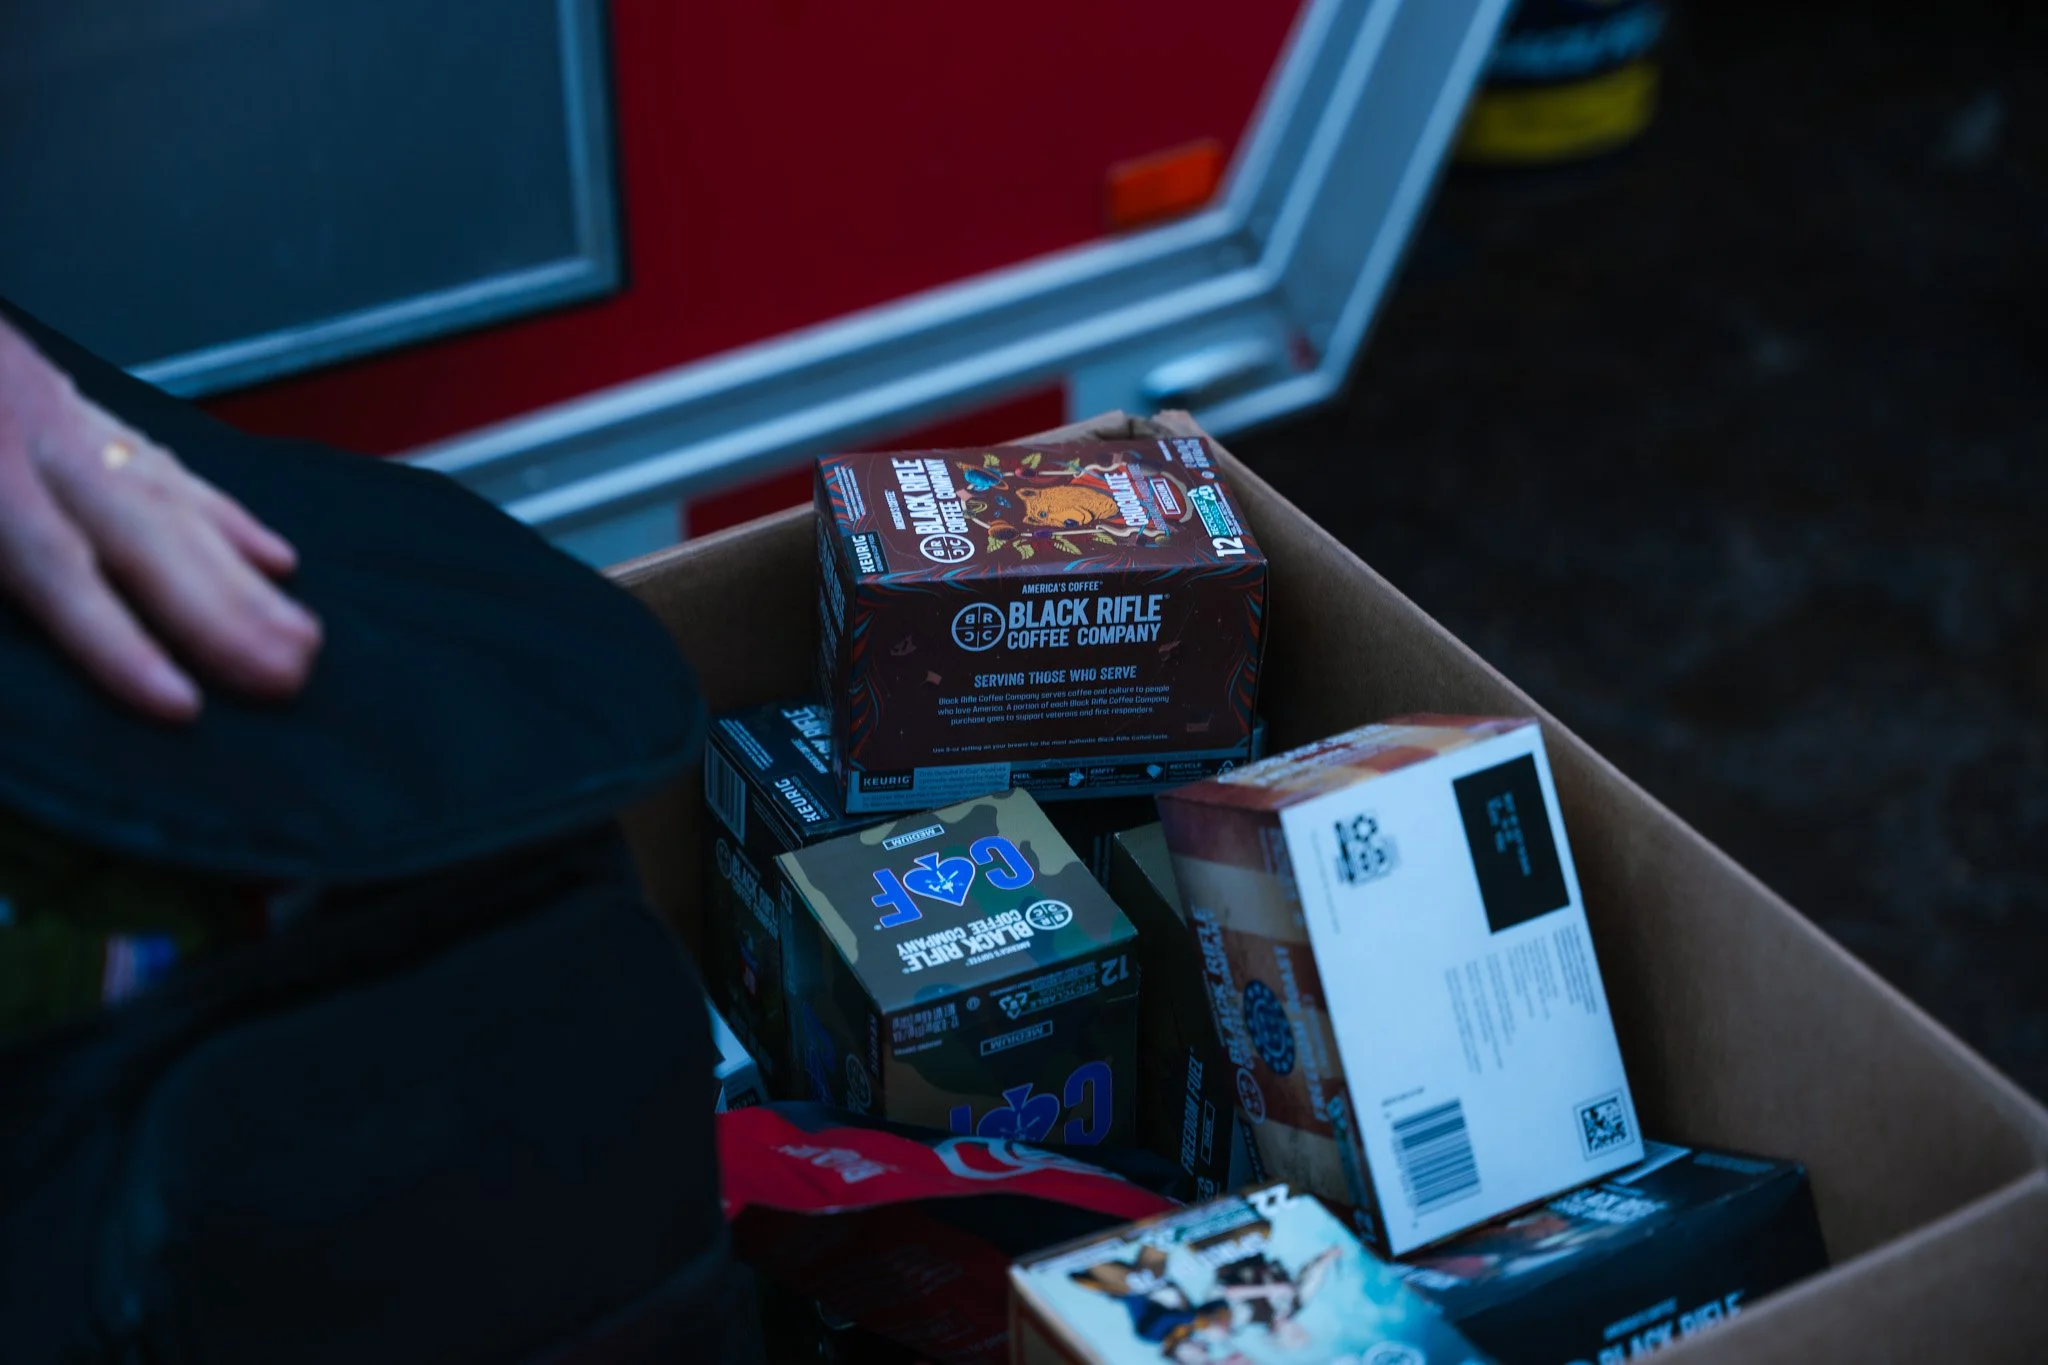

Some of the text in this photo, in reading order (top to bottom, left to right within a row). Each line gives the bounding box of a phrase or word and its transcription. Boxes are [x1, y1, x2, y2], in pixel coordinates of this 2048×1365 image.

[891, 457, 946, 534] BLACK RIFLE
[923, 458, 968, 533] COFFEE COMPANY
[1104, 472, 1149, 527] CHOCOLATE
[1155, 482, 1176, 511] MEDIUM
[852, 535, 876, 574] KEURIG
[1212, 537, 1246, 557] 12
[1022, 581, 1100, 595] AMERICA'S COFFEE
[1008, 594, 1164, 630] BLACK RIFLE
[1007, 622, 1162, 650] COFFEE COMPANY
[974, 664, 1138, 689] SERVING THOSE WHO SERVE
[937, 707, 954, 716] who
[955, 706, 971, 715] love
[1006, 703, 1012, 711] A
[1013, 701, 1040, 712] portion
[1041, 701, 1050, 710] of
[1050, 700, 1069, 709] each
[1069, 698, 1090, 708] Black
[1091, 697, 1108, 706] Rifle
[1109, 696, 1134, 705] Coffee
[1135, 694, 1170, 705] Company
[939, 684, 1170, 706] Black Rifle Coffee Company serves coffee and culture to people
[950, 715, 986, 726] purchase
[987, 715, 1005, 724] goes
[1006, 713, 1015, 721] to
[1015, 711, 1044, 721] support
[1045, 710, 1079, 720] veterans
[1079, 708, 1094, 717] and
[1094, 707, 1110, 716] first
[863, 774, 911, 787] KEURIG
[774, 777, 821, 823] KEURIG
[891, 826, 937, 847] MEDIUM
[896, 908, 1022, 954] COFFEE COMPANY
[902, 917, 1035, 974] BLACK RIFLE
[1191, 905, 1222, 977] RIFLE
[1101, 953, 1130, 987] 12
[989, 1027, 1044, 1050] MEDIUM
[1211, 979, 1246, 1064] BLACK
[1181, 1055, 1204, 1176] FREEDOM FUEL
